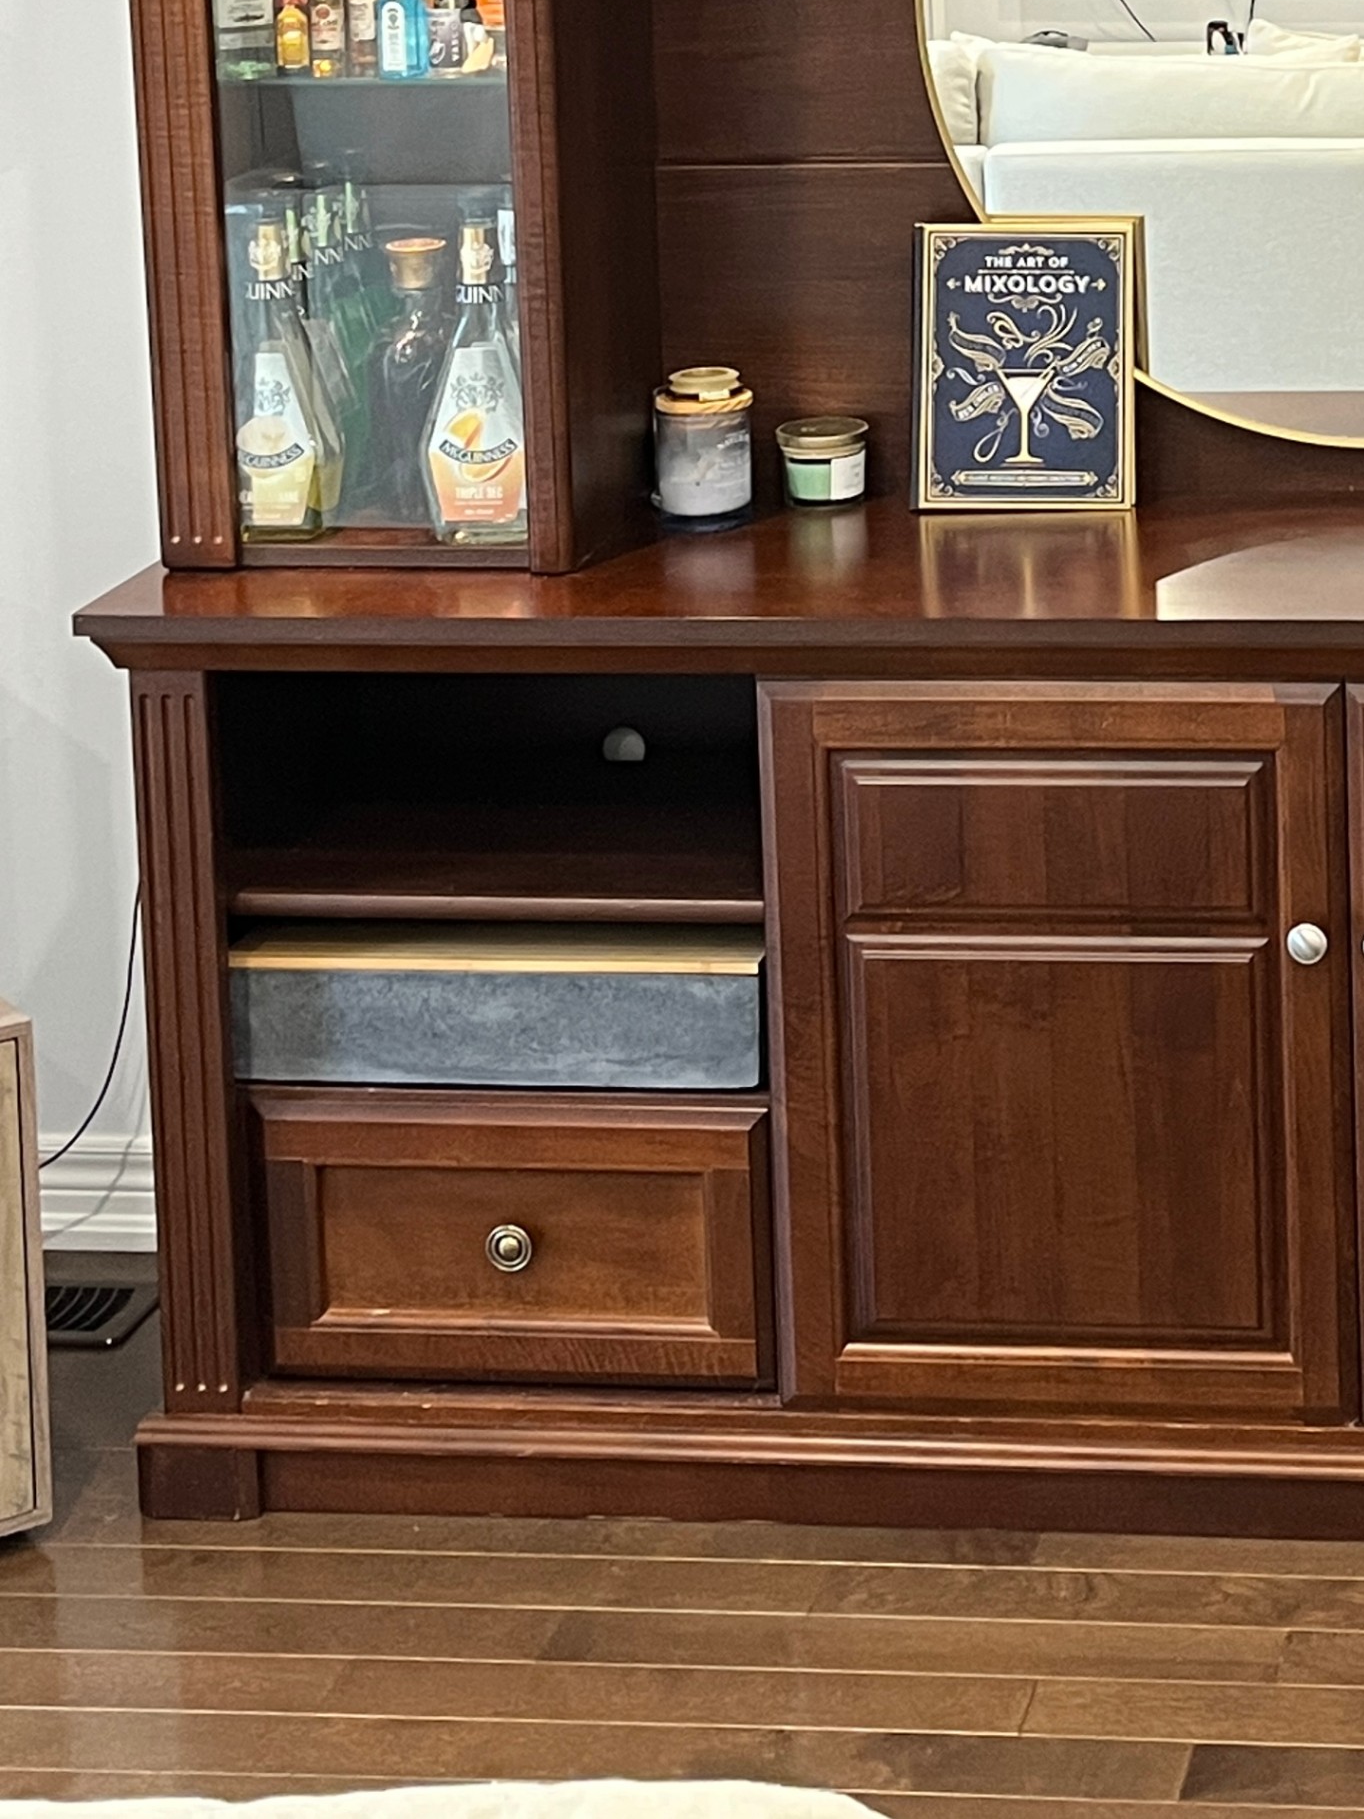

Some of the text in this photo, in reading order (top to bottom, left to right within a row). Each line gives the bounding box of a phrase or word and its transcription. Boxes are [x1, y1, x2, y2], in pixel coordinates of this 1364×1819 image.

[984, 256, 1069, 268] THE ART OF
[964, 274, 1090, 293] MIXOLOGY
